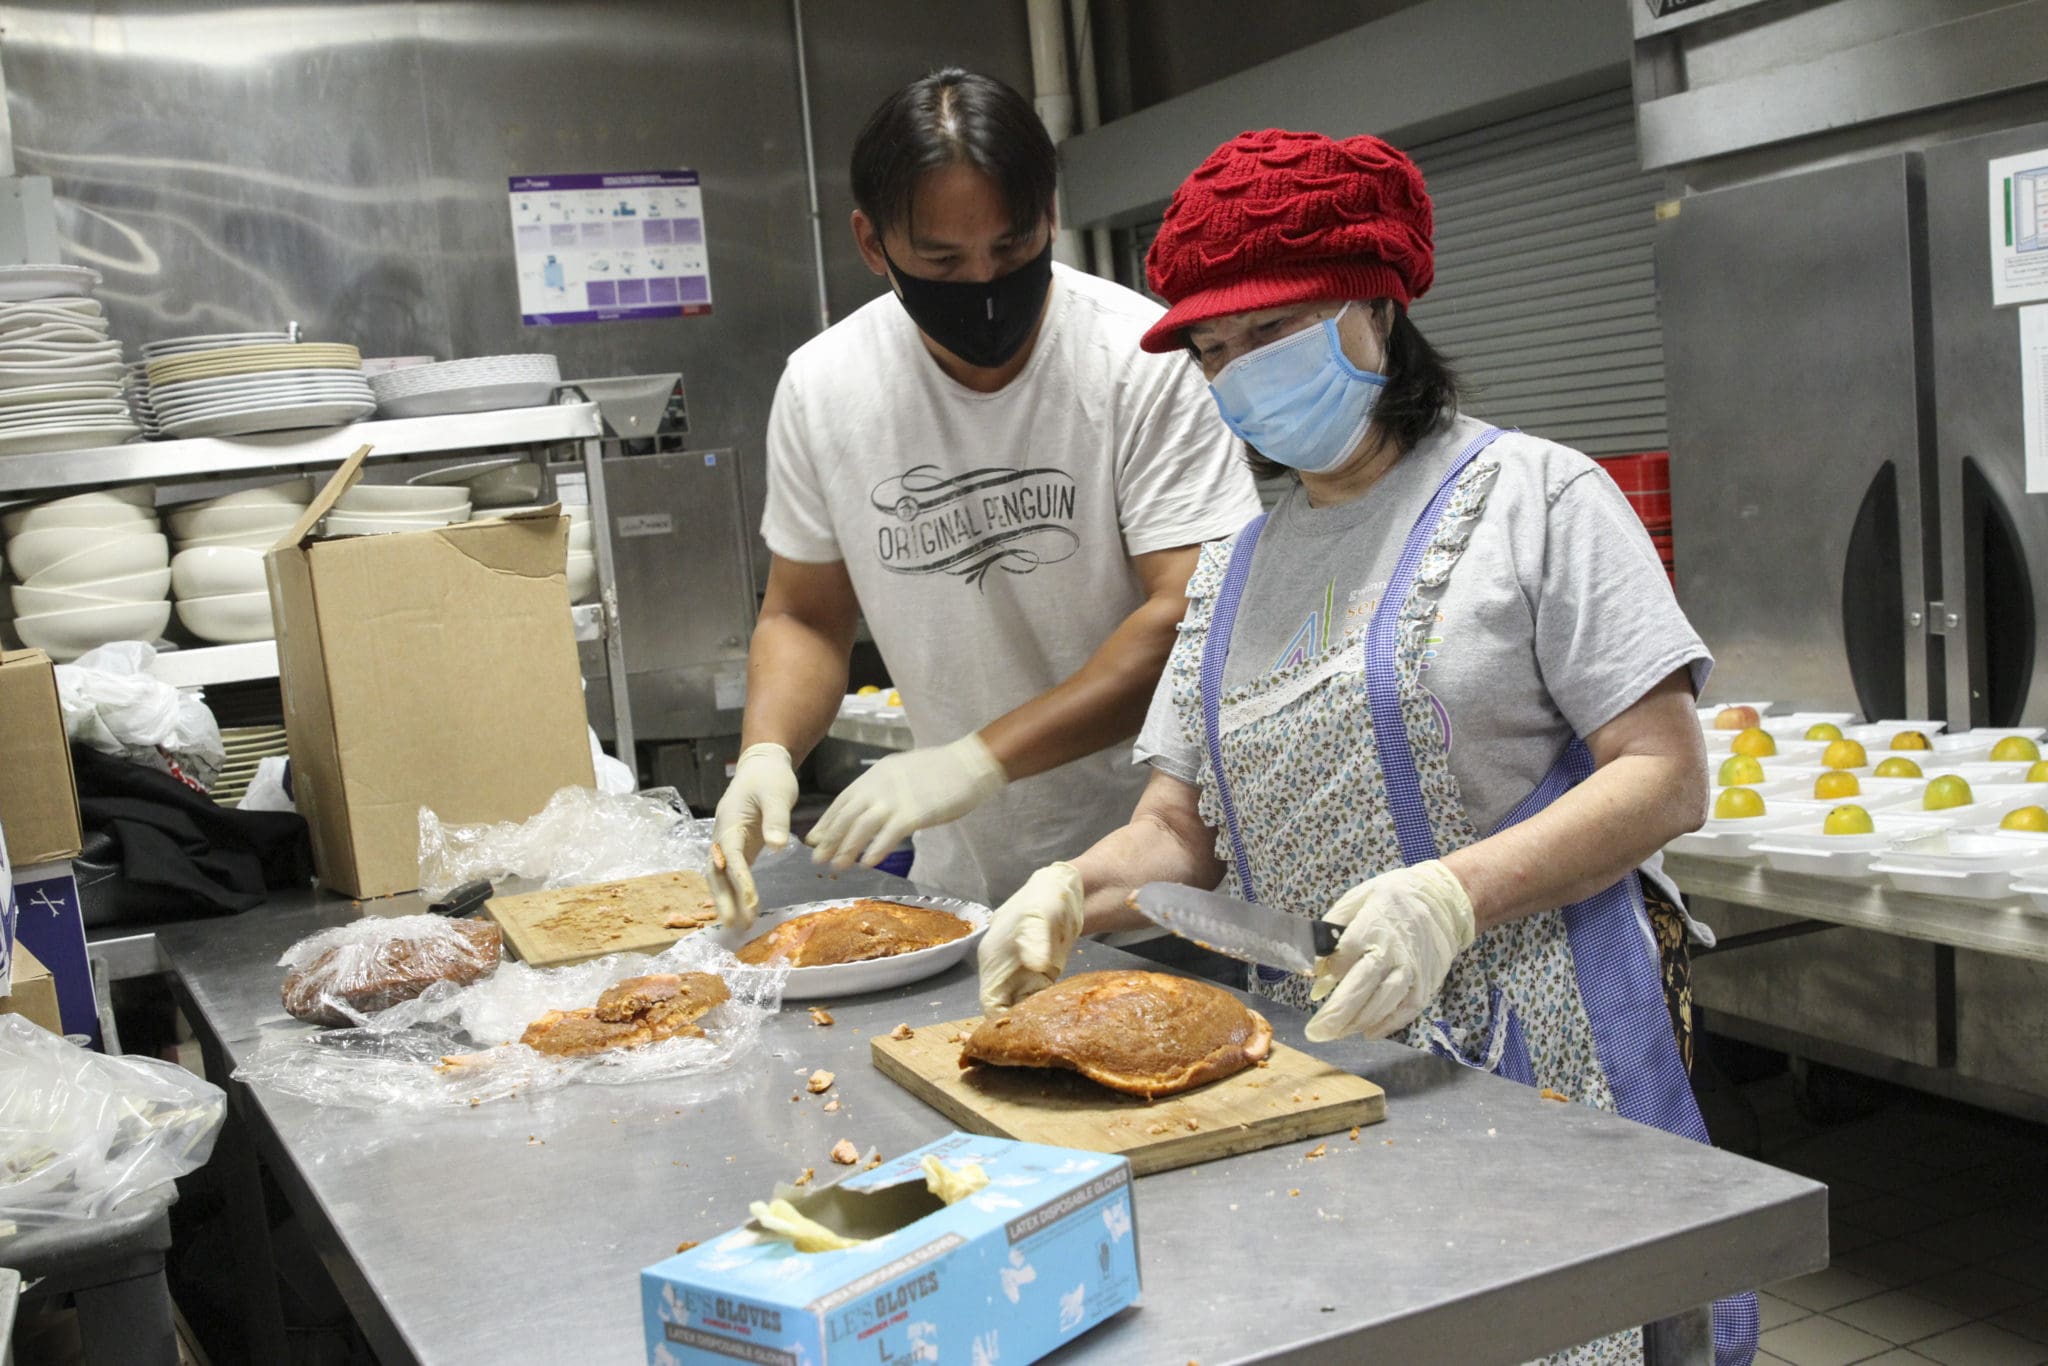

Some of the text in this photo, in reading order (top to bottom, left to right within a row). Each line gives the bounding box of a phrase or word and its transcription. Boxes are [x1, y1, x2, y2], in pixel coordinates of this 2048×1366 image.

[878, 484, 1076, 561] ORIGINAL PENGUIN
[1009, 1216, 1039, 1240] LATEX
[1040, 1186, 1094, 1223] DISPOSABLE
[1094, 1168, 1128, 1195] GLOVES
[715, 1296, 782, 1333] GLOVES
[874, 1270, 939, 1318] GLOVES
